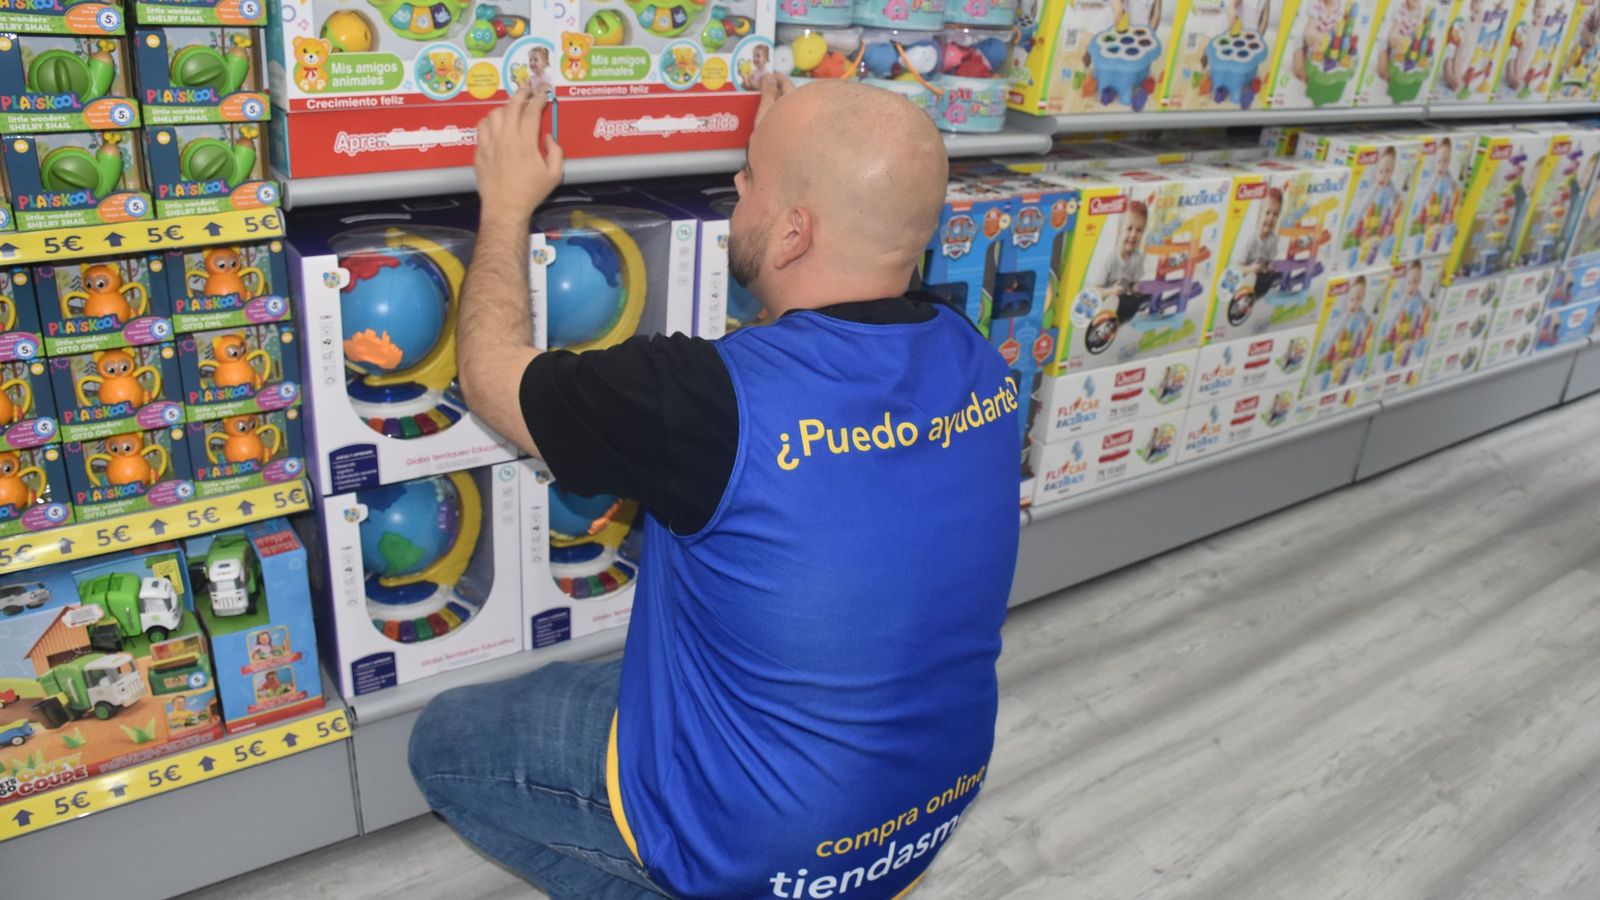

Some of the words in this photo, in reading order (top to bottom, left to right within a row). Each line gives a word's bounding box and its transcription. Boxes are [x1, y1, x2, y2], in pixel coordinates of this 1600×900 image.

[331, 63, 354, 75] Mis
[356, 61, 398, 75] amigos
[591, 54, 610, 65] Mis
[611, 54, 646, 67] amigos
[591, 65, 635, 76] animales
[332, 75, 385, 88] animales
[569, 86, 628, 97] Crecimiento
[629, 85, 650, 95] feliz
[1, 93, 81, 111] PLAYSKOOL
[146, 88, 218, 104] PLAYSKOOL
[306, 97, 378, 110] Crecimiento
[381, 96, 405, 106] feliz
[159, 180, 229, 199] PLAYSKOOL
[18, 191, 96, 210] PLAYSKOOL
[44, 235, 84, 254] 5€
[147, 225, 184, 243] 5€
[244, 214, 279, 232] 5€
[176, 294, 243, 313] PLAYSKOOL
[48, 316, 121, 337] PLAYSKOOL
[189, 383, 254, 404] PLAYSKOOL
[64, 401, 134, 424] PLAYSKOOL
[777, 411, 919, 471] ¿Puedo
[928, 376, 1019, 449] ayudarte?
[198, 460, 260, 480] PLAYSKOOL
[76, 481, 145, 503] PLAYSKOOL
[0, 544, 34, 567] 5€
[97, 525, 132, 547] 5€
[187, 507, 220, 528] 5€
[273, 489, 305, 509] 5€
[17, 753, 82, 783] COZY
[55, 791, 91, 815] 5€
[148, 764, 182, 788] 5€
[234, 740, 266, 763] 5€
[317, 716, 347, 739] 5€
[19, 766, 88, 796] COUPE
[815, 807, 919, 858] compra
[926, 766, 986, 814] online
[769, 814, 960, 899] tiendasm
